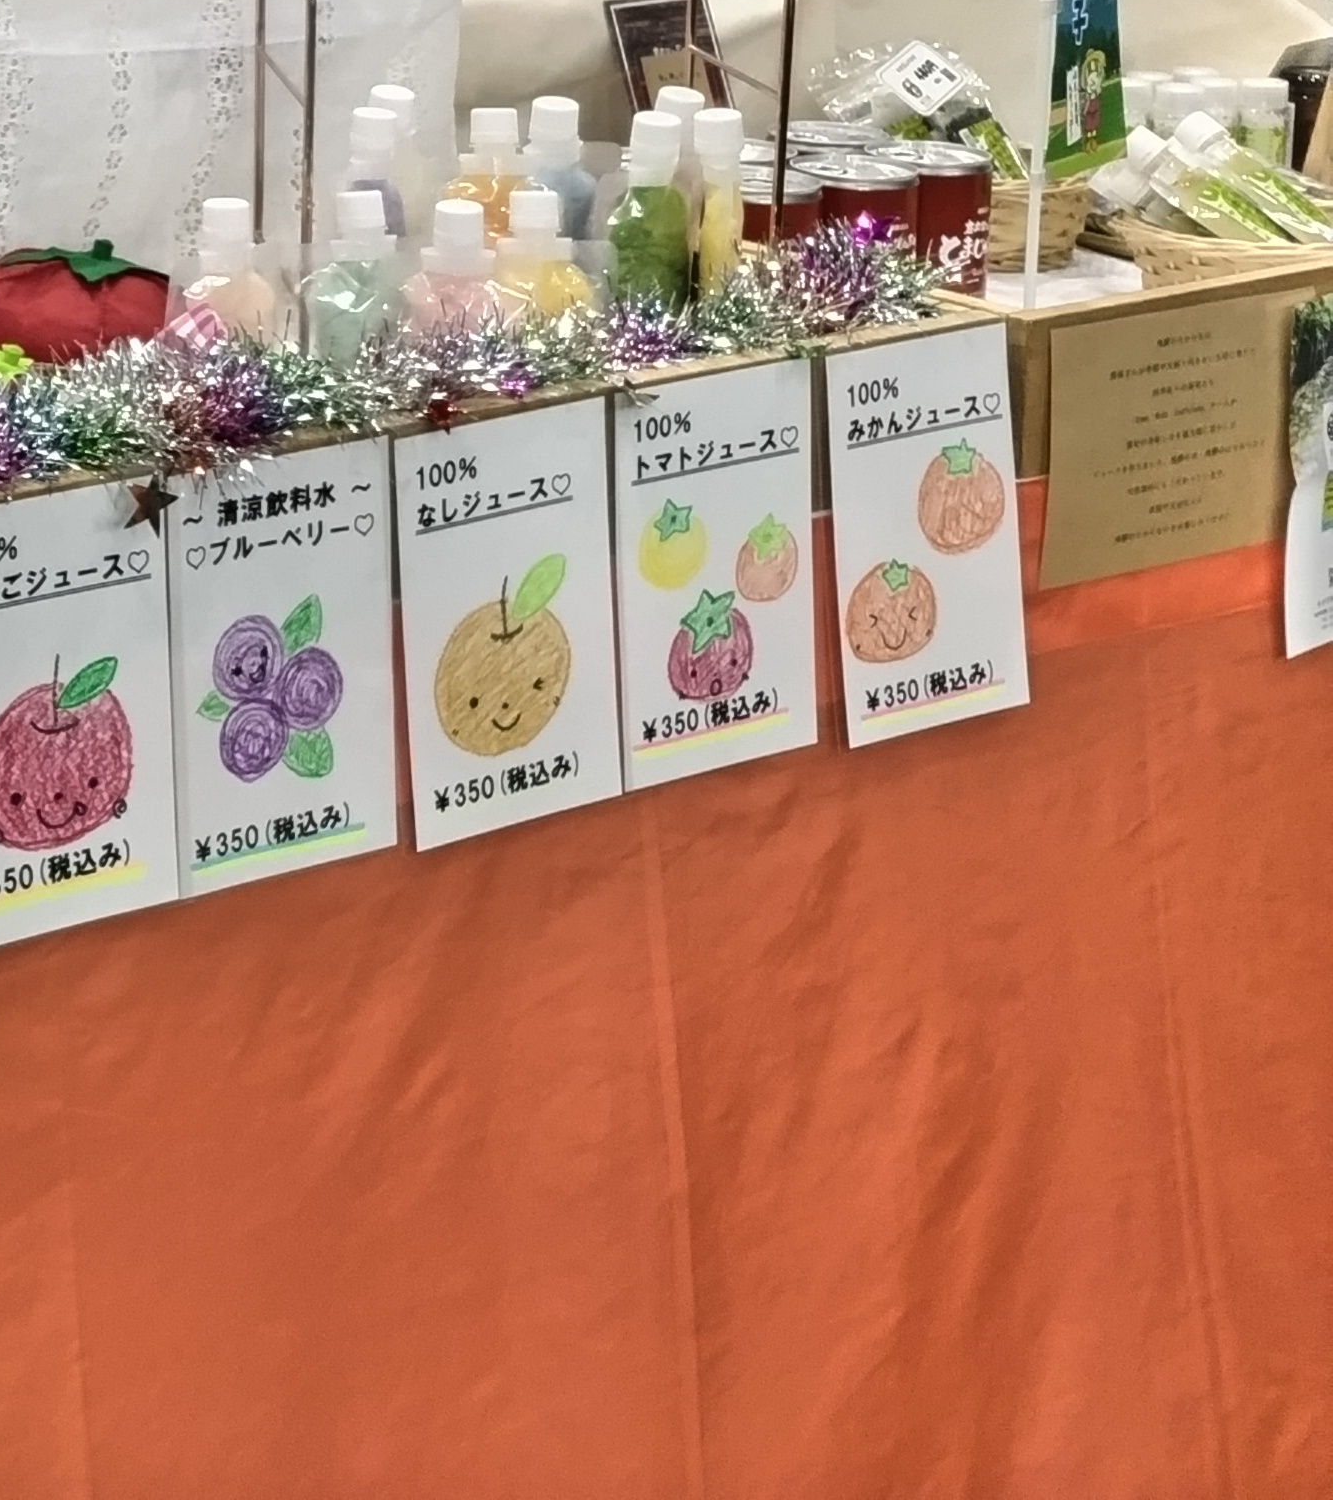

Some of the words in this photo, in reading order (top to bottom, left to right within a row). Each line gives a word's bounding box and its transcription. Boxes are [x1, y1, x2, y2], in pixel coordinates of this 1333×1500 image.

[846, 376, 900, 409] 100%
[847, 393, 982, 444] みかんジュース
[632, 410, 693, 444] 100%
[635, 426, 780, 479] トマトジュース
[415, 456, 479, 492] 100%
[216, 480, 338, 528] 清涼飲料水
[416, 475, 549, 528] なしジュース
[210, 521, 351, 567] ブルーベリー
[865, 659, 996, 713] ¥350(税込み)
[641, 686, 780, 745] ¥350(税込み)
[433, 750, 581, 814] ¥350(税込み)
[194, 801, 352, 864] ¥350(税込み)
